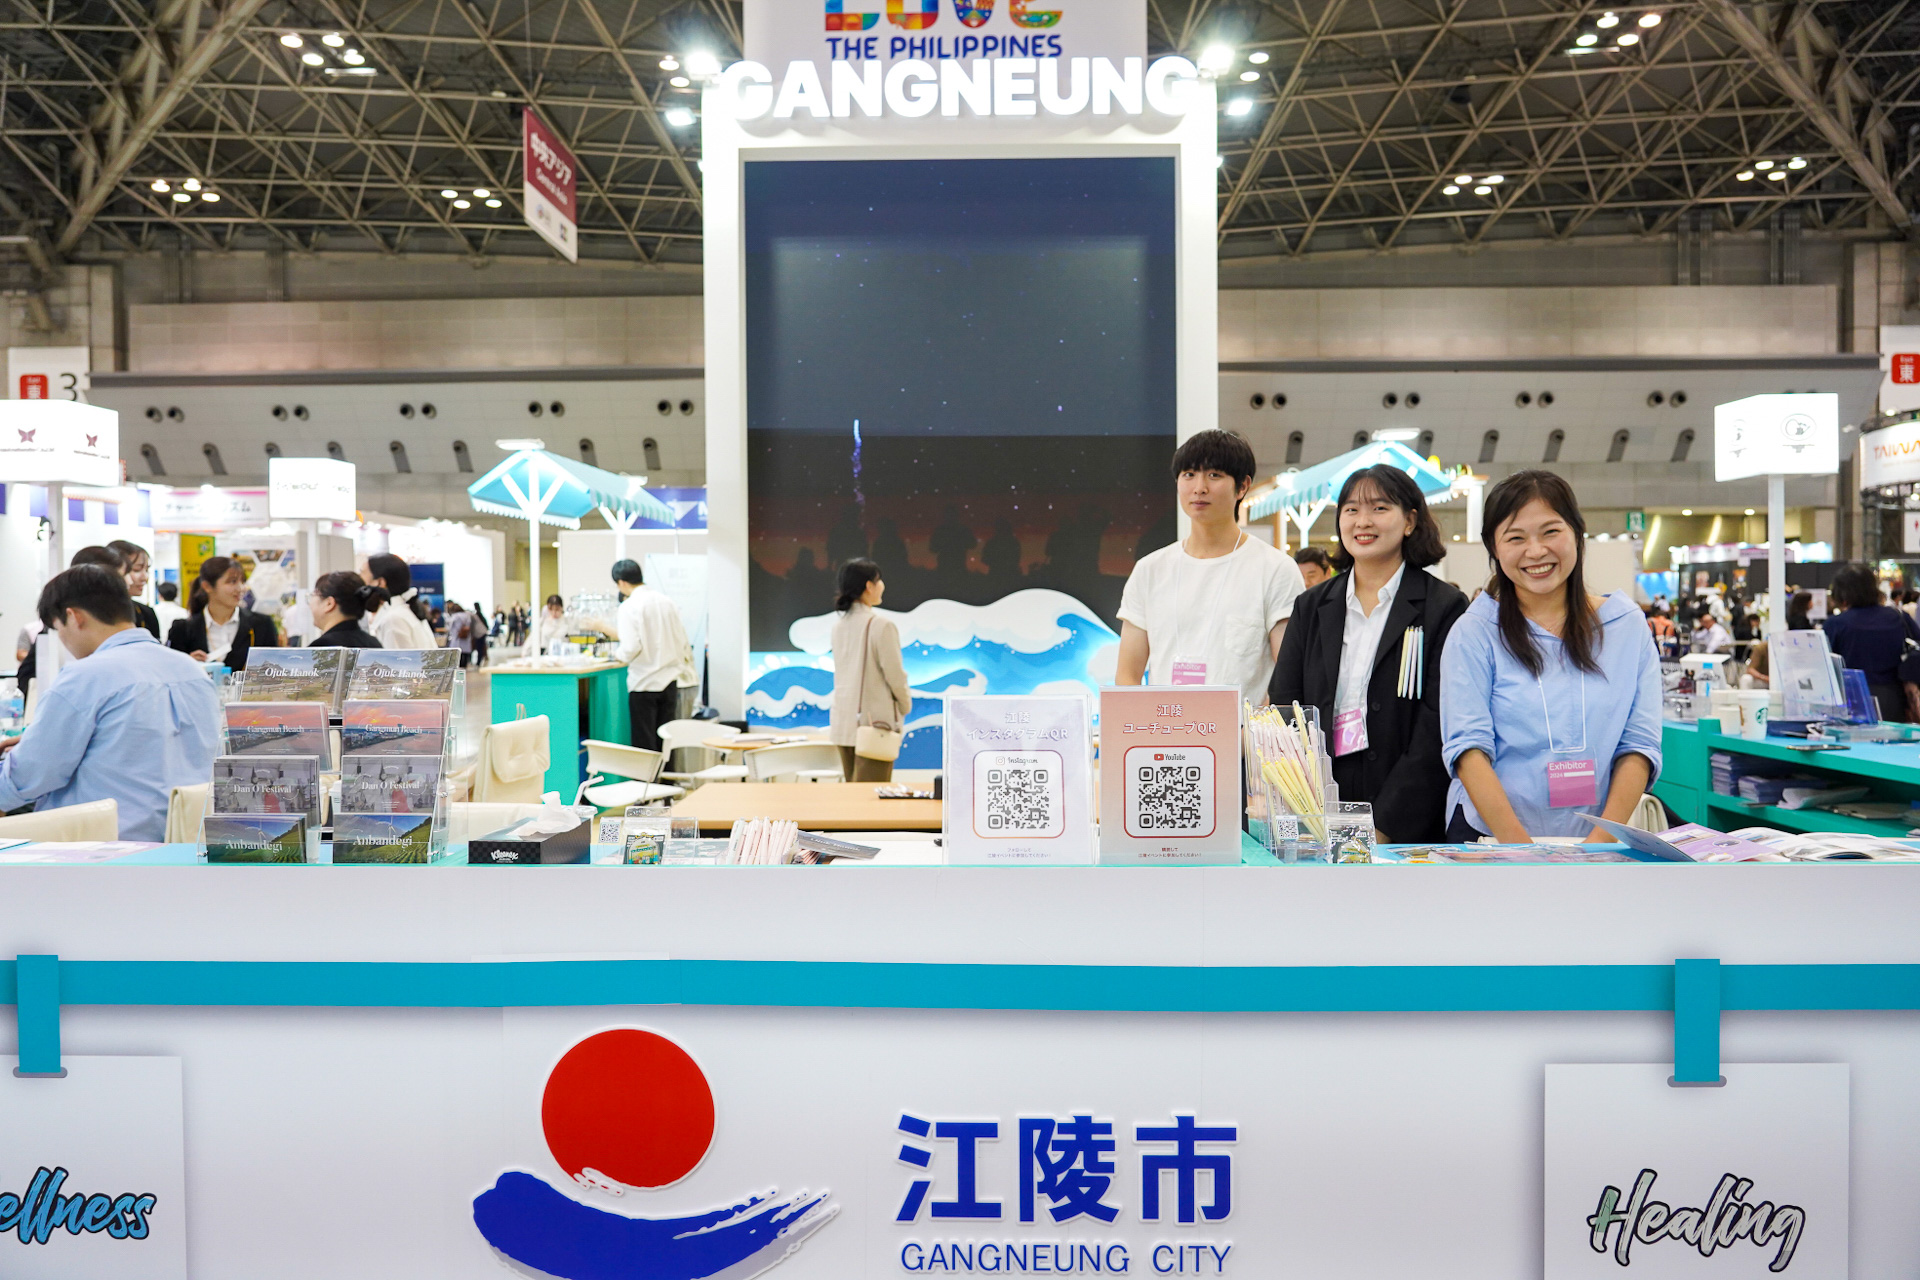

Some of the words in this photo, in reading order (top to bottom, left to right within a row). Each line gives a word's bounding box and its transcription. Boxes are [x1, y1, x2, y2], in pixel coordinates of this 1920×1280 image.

[825, 37, 879, 60] THE
[890, 34, 1063, 60] PHILIPPINES
[718, 56, 1200, 121] GANGNEUNG
[1899, 364, 1915, 383] 東
[60, 372, 77, 401] 3
[265, 668, 288, 678] Ojuk
[289, 668, 319, 677] Hanok
[373, 668, 396, 678] Ojuk
[397, 668, 428, 678] Hanok
[1156, 704, 1183, 717] 江陵
[1004, 711, 1031, 724] 江陵
[283, 724, 305, 733] Beach
[401, 724, 423, 734] Beach
[1122, 721, 1217, 736] ユーチューブQR
[1008, 756, 1038, 767] Instagram
[1164, 753, 1186, 761] YouTube
[1549, 761, 1588, 771] Exhibitor
[234, 784, 251, 793] Dan
[252, 784, 260, 793] O
[261, 784, 292, 793] Festival
[361, 781, 379, 790] Dan
[380, 781, 388, 789] O
[389, 781, 420, 790] Festival
[225, 839, 283, 854] Anbandegi
[353, 834, 413, 849] Anbandegi
[895, 1114, 1237, 1223] 江陵市
[1586, 1168, 1806, 1272] Healing
[900, 1243, 1130, 1272] GANGNEUNG
[1151, 1244, 1232, 1273] CITY
